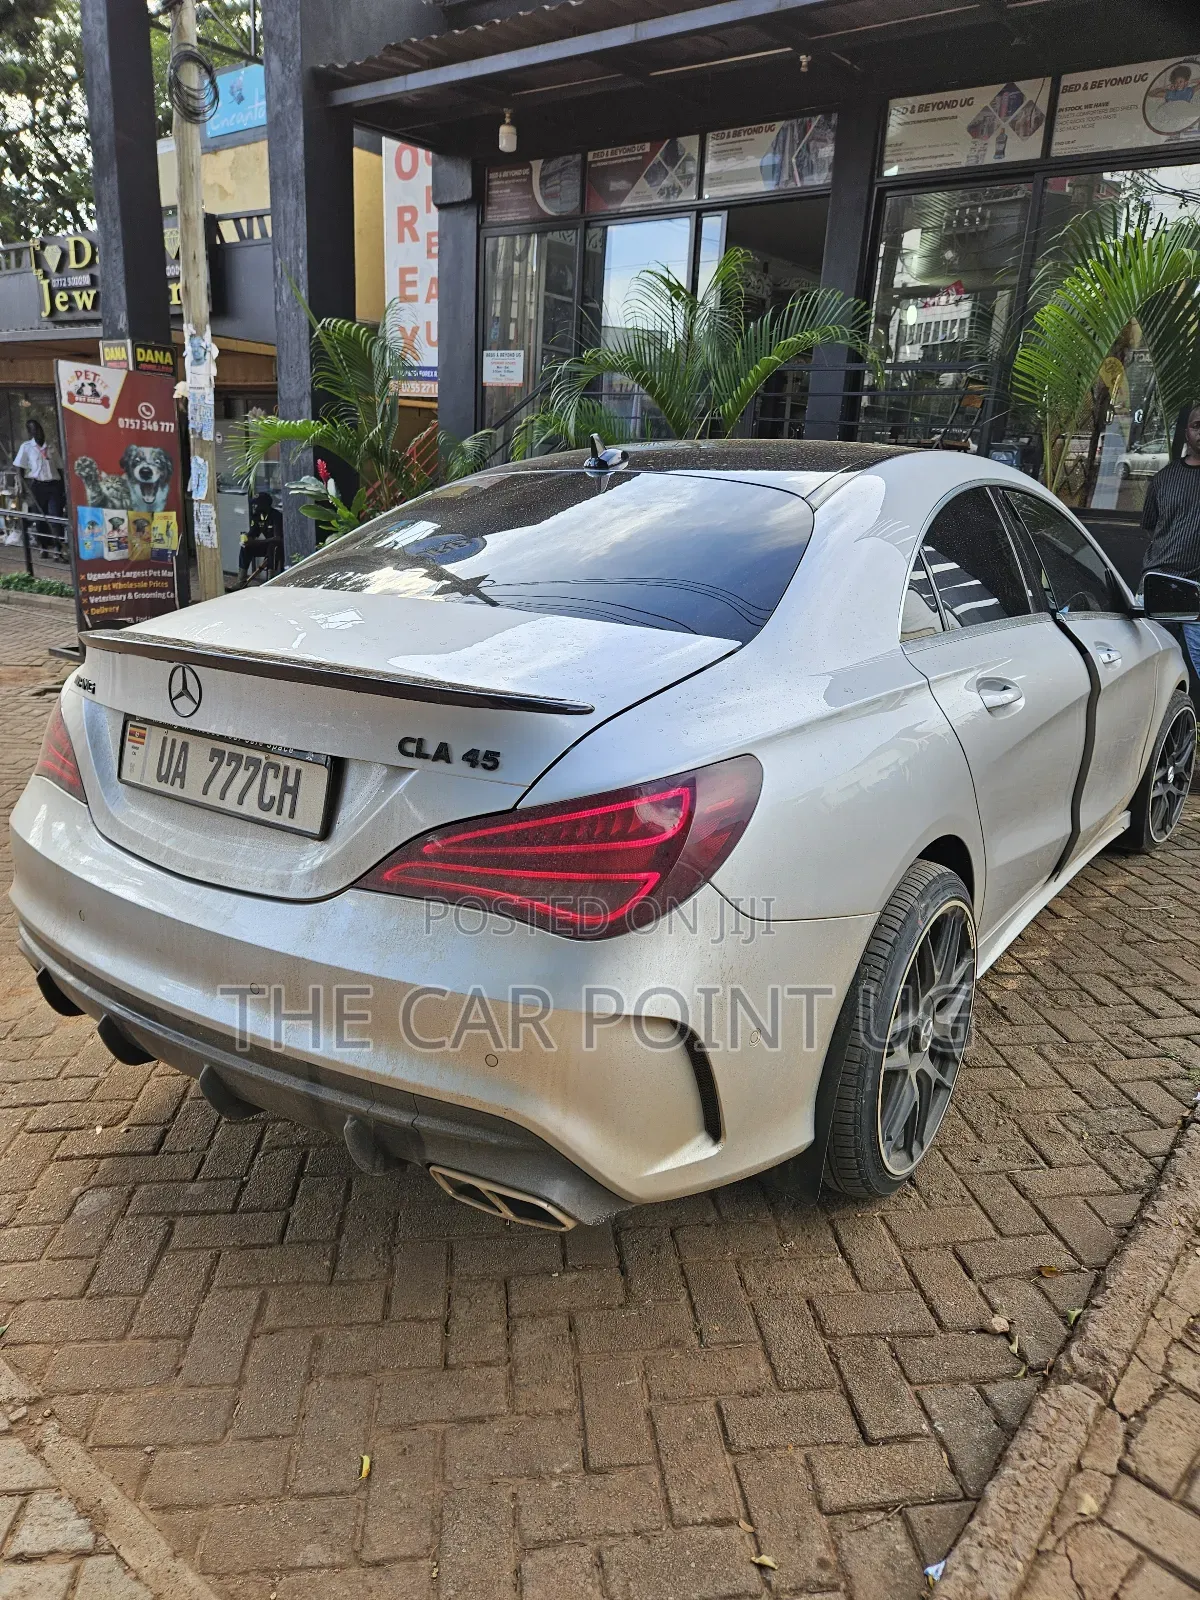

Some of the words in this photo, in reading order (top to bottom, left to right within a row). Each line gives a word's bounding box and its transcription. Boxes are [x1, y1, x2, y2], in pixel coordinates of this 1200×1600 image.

[1060, 83, 1082, 94] BED
[1082, 82, 1089, 91] &
[1089, 76, 1133, 90] BEYOND
[1133, 72, 1149, 83] UG
[910, 105, 917, 115] &
[917, 99, 959, 113] BEYOND
[960, 97, 975, 107] UG
[711, 132, 726, 140] BED
[726, 131, 731, 139] &
[732, 126, 764, 138] BEYOND
[764, 124, 776, 132] UG
[592, 151, 605, 159] BED
[610, 146, 636, 157] BEYOND
[637, 144, 646, 152] UG
[104, 346, 127, 361] DANA
[136, 348, 173, 366] DANA
[118, 418, 139, 429] 0757
[142, 420, 158, 432] 346
[160, 422, 175, 433] 777
[87, 571, 121, 581] Uganda's
[121, 569, 148, 580] Largest
[148, 569, 160, 577] Pet
[88, 584, 102, 592] Buy
[103, 583, 111, 591] at
[112, 581, 147, 590] Wholesale
[149, 580, 168, 588] Prices
[89, 593, 127, 604] Veterinary
[127, 592, 133, 600] &
[134, 591, 166, 600] Grooming
[90, 605, 120, 615] Delivery
[398, 736, 452, 764] CLA
[461, 748, 500, 771] 45
[157, 735, 189, 790] UA
[202, 747, 301, 820] 777CH
